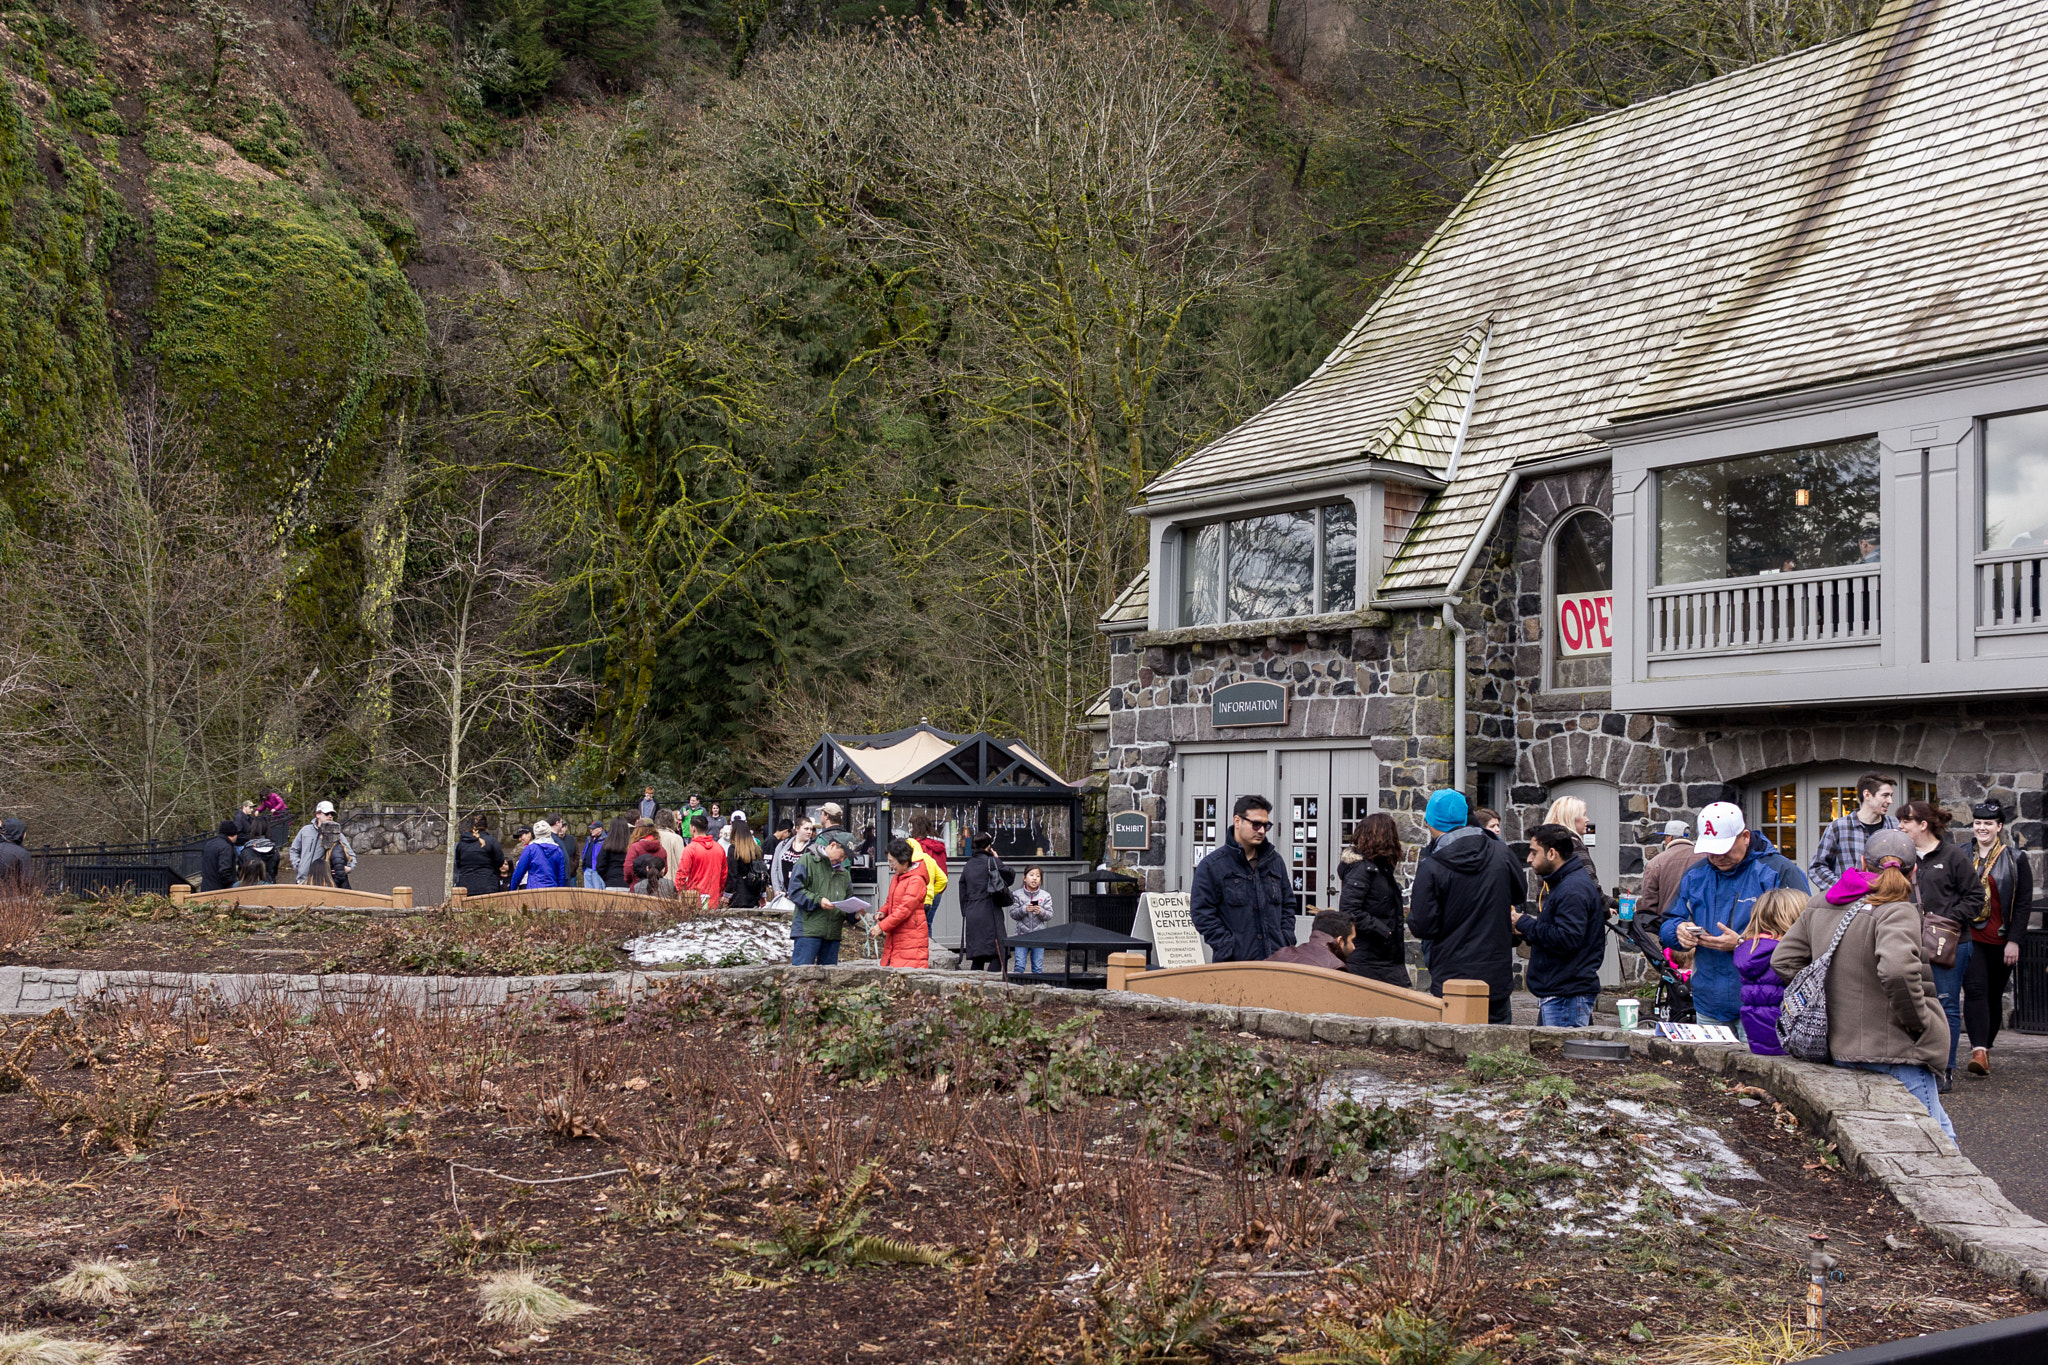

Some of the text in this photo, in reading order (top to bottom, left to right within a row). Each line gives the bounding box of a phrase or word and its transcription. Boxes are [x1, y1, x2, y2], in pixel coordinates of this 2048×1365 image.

[1218, 699, 1278, 713] INFORMATION
[1115, 823, 1144, 832] EXHIBIT
[1158, 897, 1184, 906] OPEN
[1154, 910, 1191, 918] VISITOR
[1155, 919, 1194, 928] CENTER
